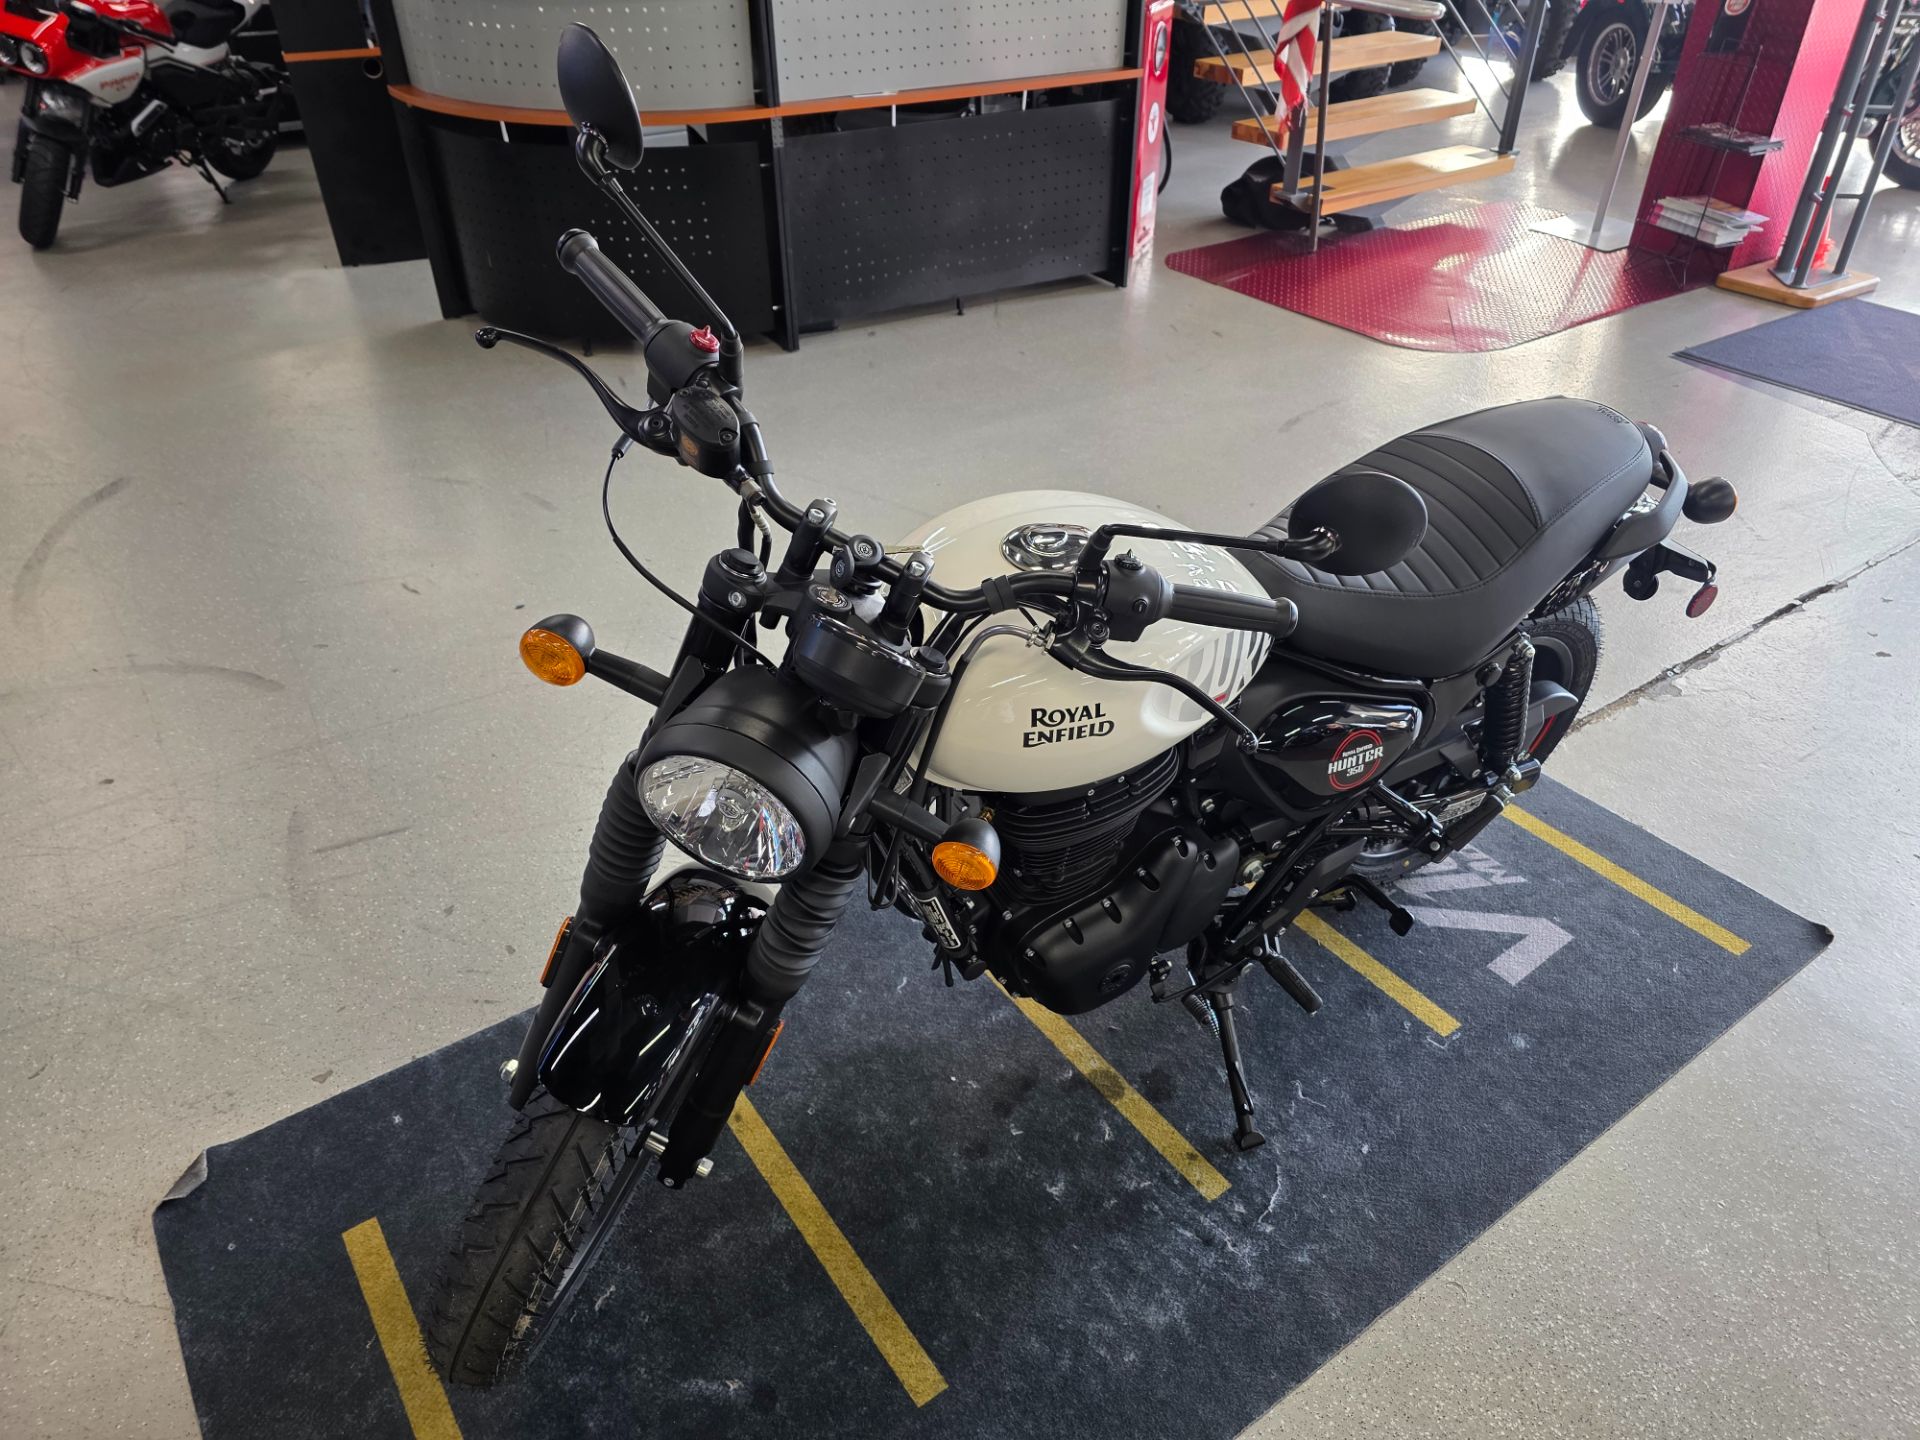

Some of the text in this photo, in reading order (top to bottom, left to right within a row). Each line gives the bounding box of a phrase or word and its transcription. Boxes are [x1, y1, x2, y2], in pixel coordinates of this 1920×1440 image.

[1031, 703, 1106, 728] ROYAL
[1023, 720, 1115, 748] ENFIELD
[1328, 746, 1383, 775] HUNTER
[1346, 764, 1364, 777] 350
